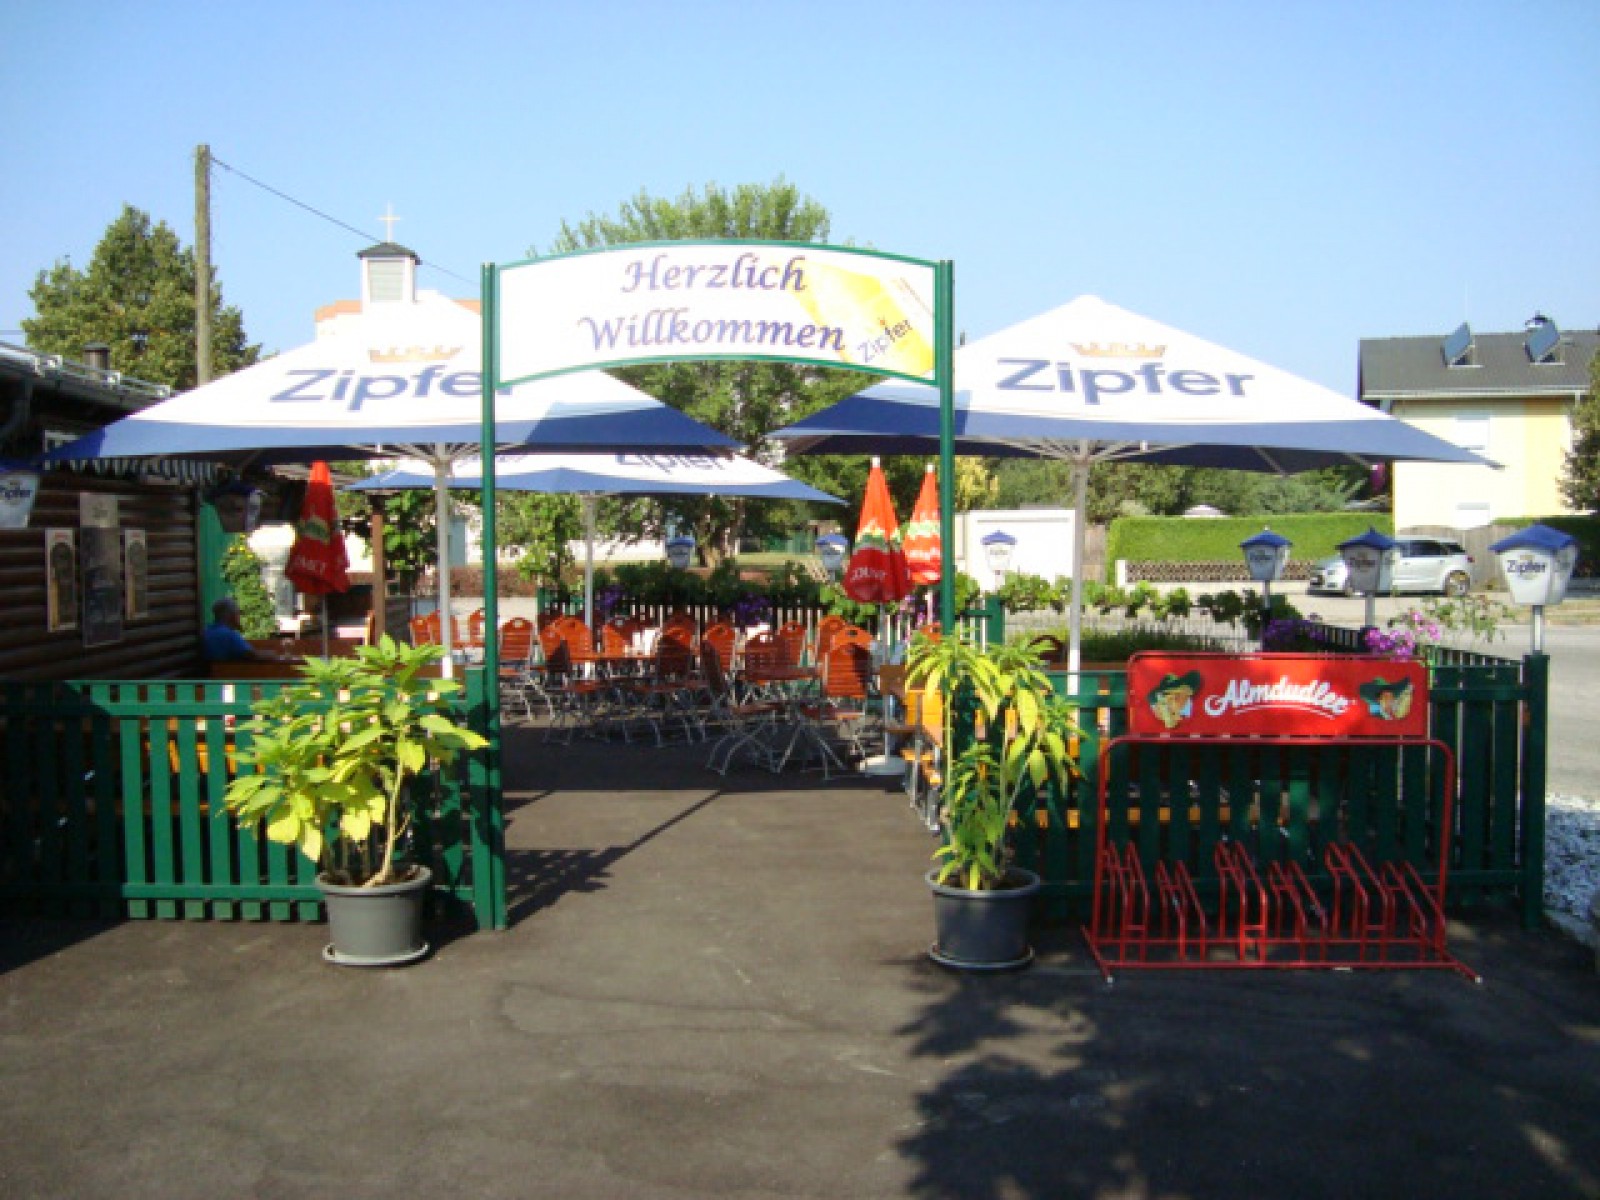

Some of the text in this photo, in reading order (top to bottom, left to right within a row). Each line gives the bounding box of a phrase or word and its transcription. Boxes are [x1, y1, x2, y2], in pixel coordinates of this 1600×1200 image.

[620, 252, 808, 293] Herzlich
[576, 307, 846, 352] Willkommen
[995, 358, 1255, 406] Zipfer
[1203, 674, 1350, 718] Almdudler
